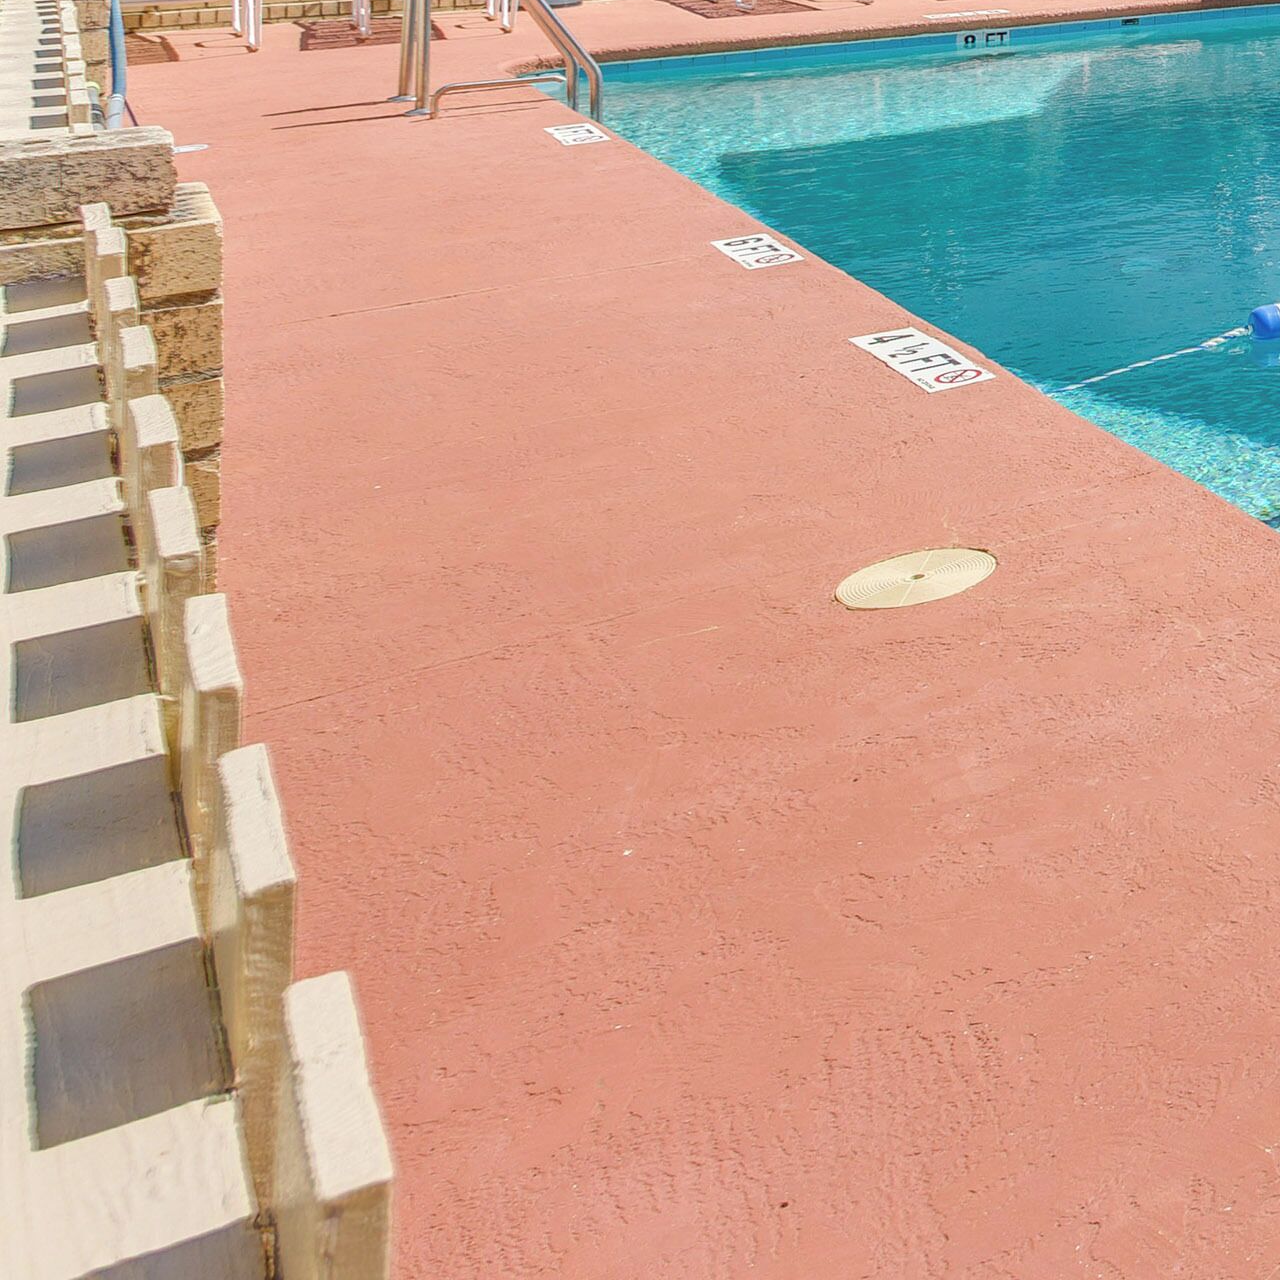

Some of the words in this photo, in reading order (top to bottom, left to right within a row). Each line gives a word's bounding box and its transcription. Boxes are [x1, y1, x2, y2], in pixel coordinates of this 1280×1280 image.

[985, 32, 1008, 48] FT
[731, 244, 781, 257] FT
[867, 333, 915, 345] 4
[899, 353, 962, 373] FT
